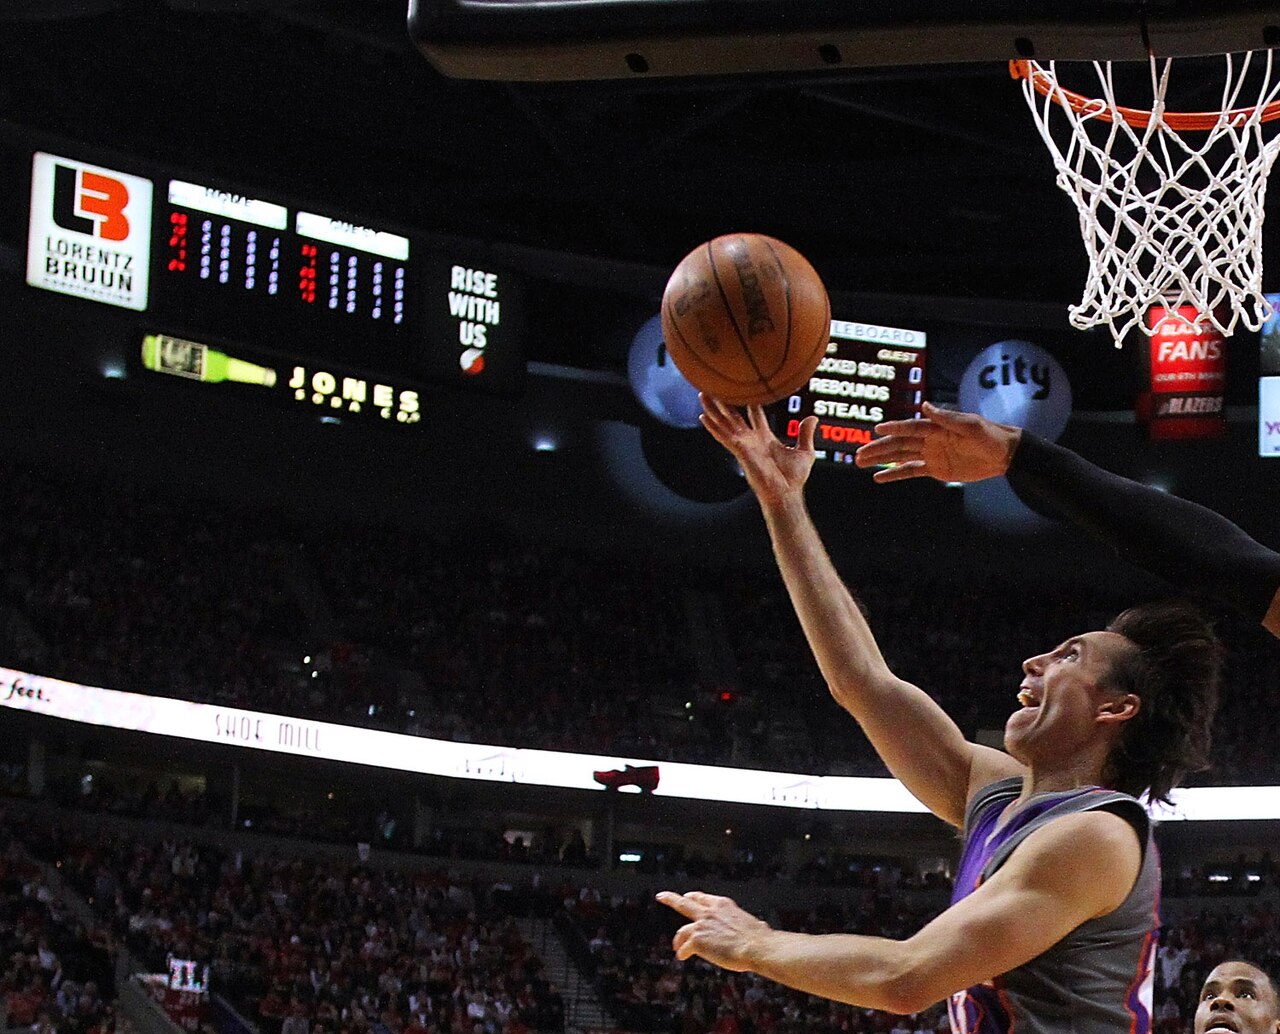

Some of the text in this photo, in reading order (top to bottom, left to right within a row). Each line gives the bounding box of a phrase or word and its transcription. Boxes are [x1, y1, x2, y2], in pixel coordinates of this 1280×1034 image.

[47, 236, 133, 270] LORENTZ
[46, 257, 132, 292] BRUUN
[451, 265, 498, 298] RISE
[448, 291, 500, 325] WITH
[460, 320, 487, 348] US
[1158, 340, 1221, 362] FANS
[289, 366, 419, 413] JONES
[809, 377, 890, 401] REBOUNDS
[909, 367, 922, 384] 0
[978, 354, 1050, 399] city
[788, 395, 883, 421] 0 STEALS
[6, 679, 50, 702] feet.
